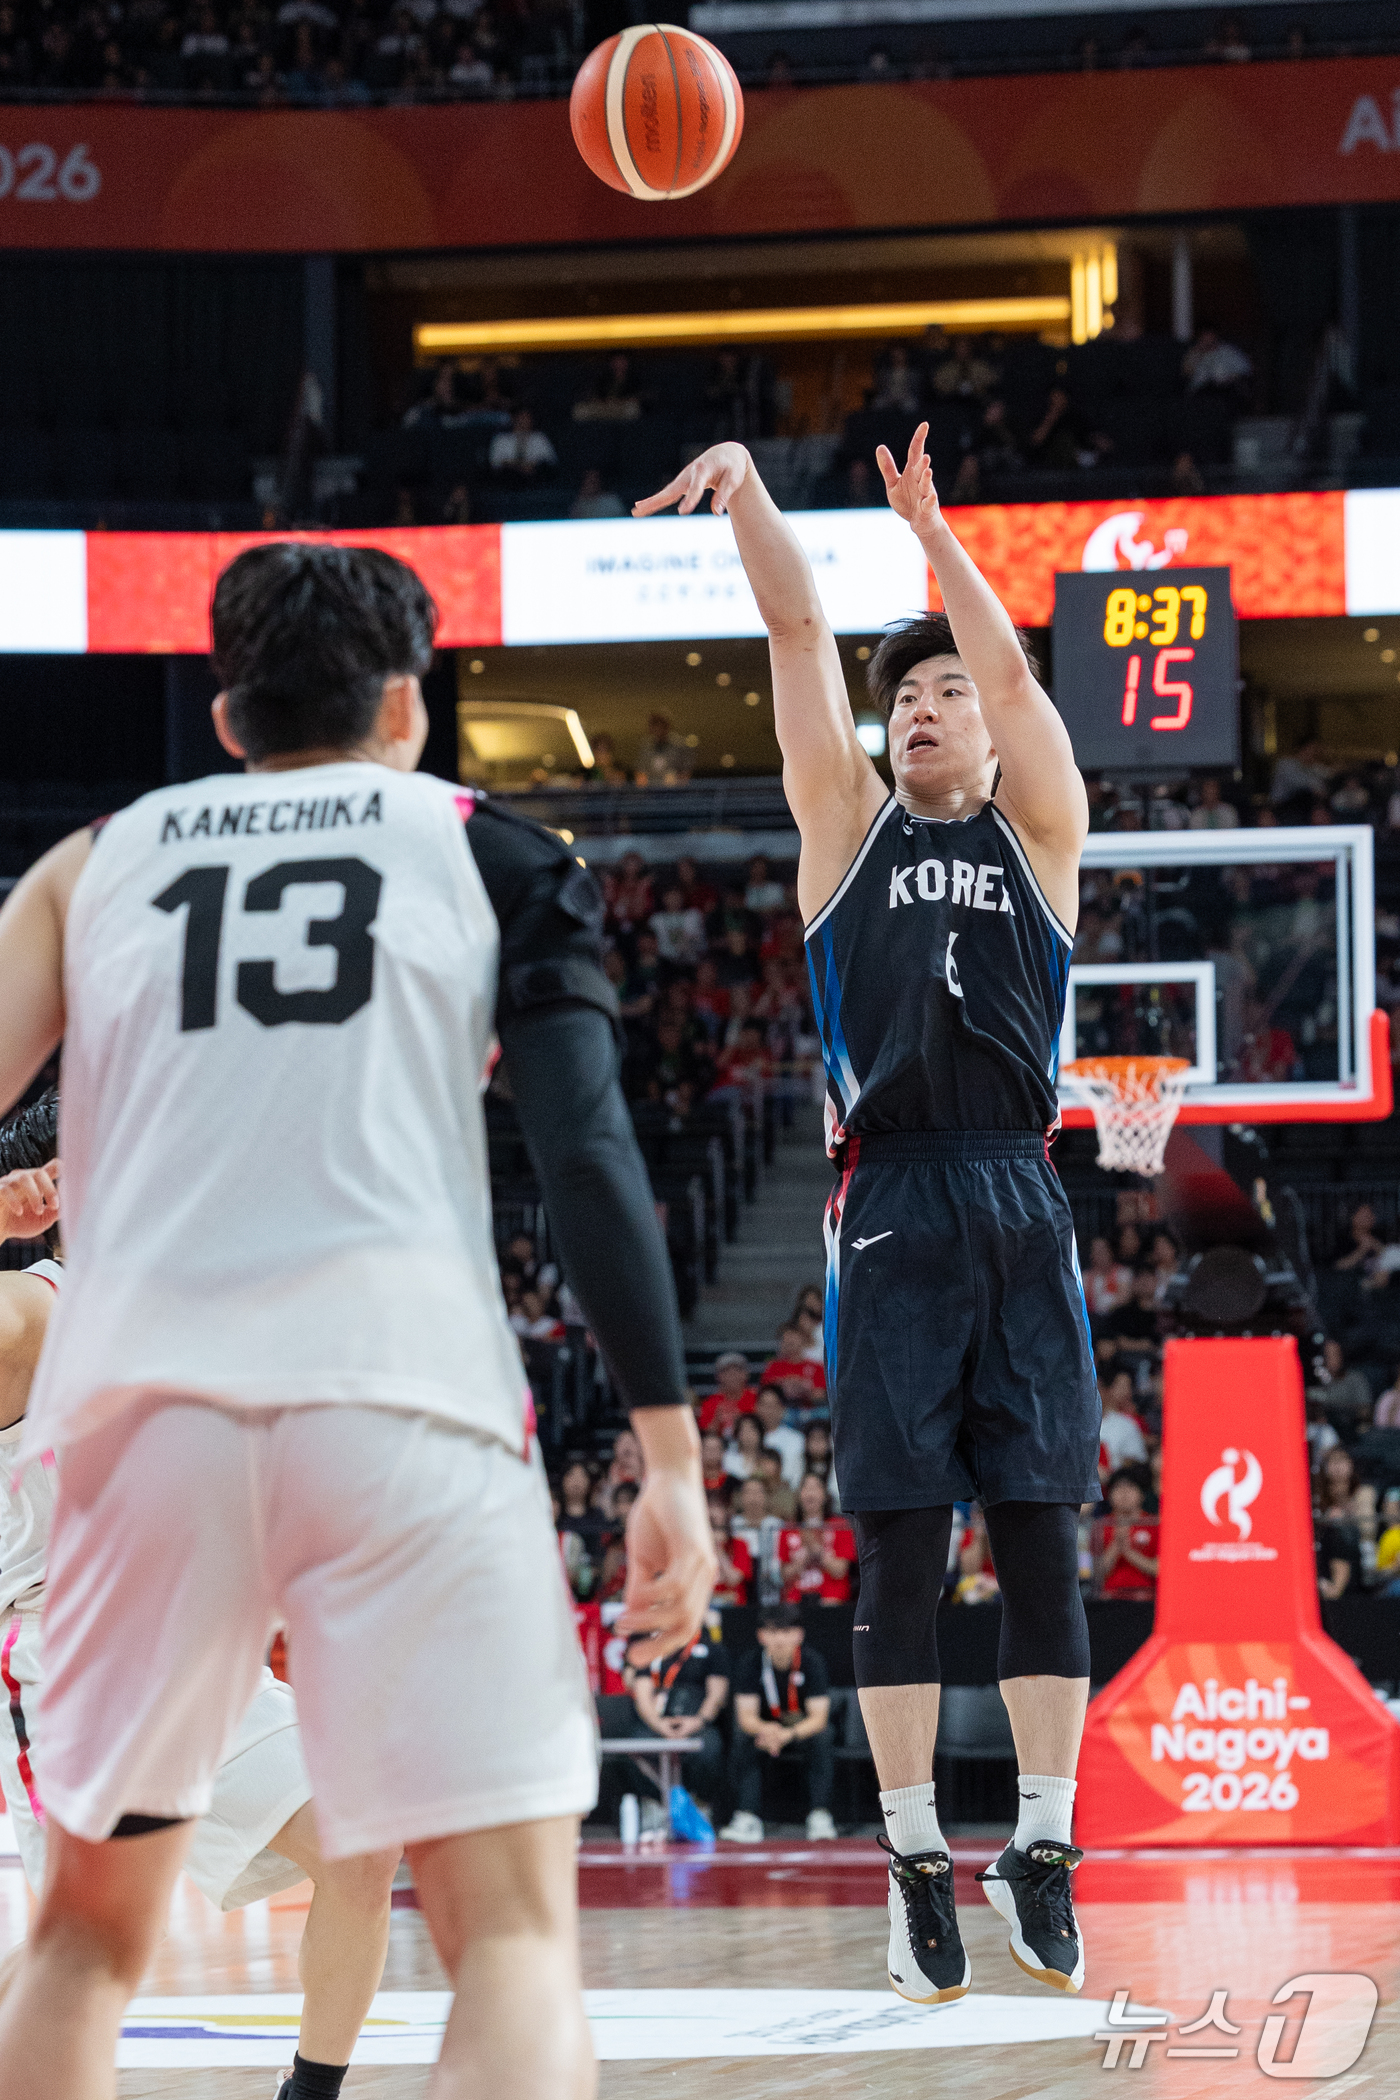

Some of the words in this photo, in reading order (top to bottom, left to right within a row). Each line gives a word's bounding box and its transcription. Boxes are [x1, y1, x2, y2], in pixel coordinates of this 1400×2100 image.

[640, 74, 662, 153] molten
[1104, 586, 1207, 647] 8:37
[1121, 647, 1195, 731] 15
[161, 790, 383, 844] KANECHIKA
[151, 857, 383, 1034] 13
[1171, 1677, 1311, 1722] Aichi-
[1151, 1723, 1329, 1771] Nagoya
[1181, 1771, 1299, 1811] 2026
